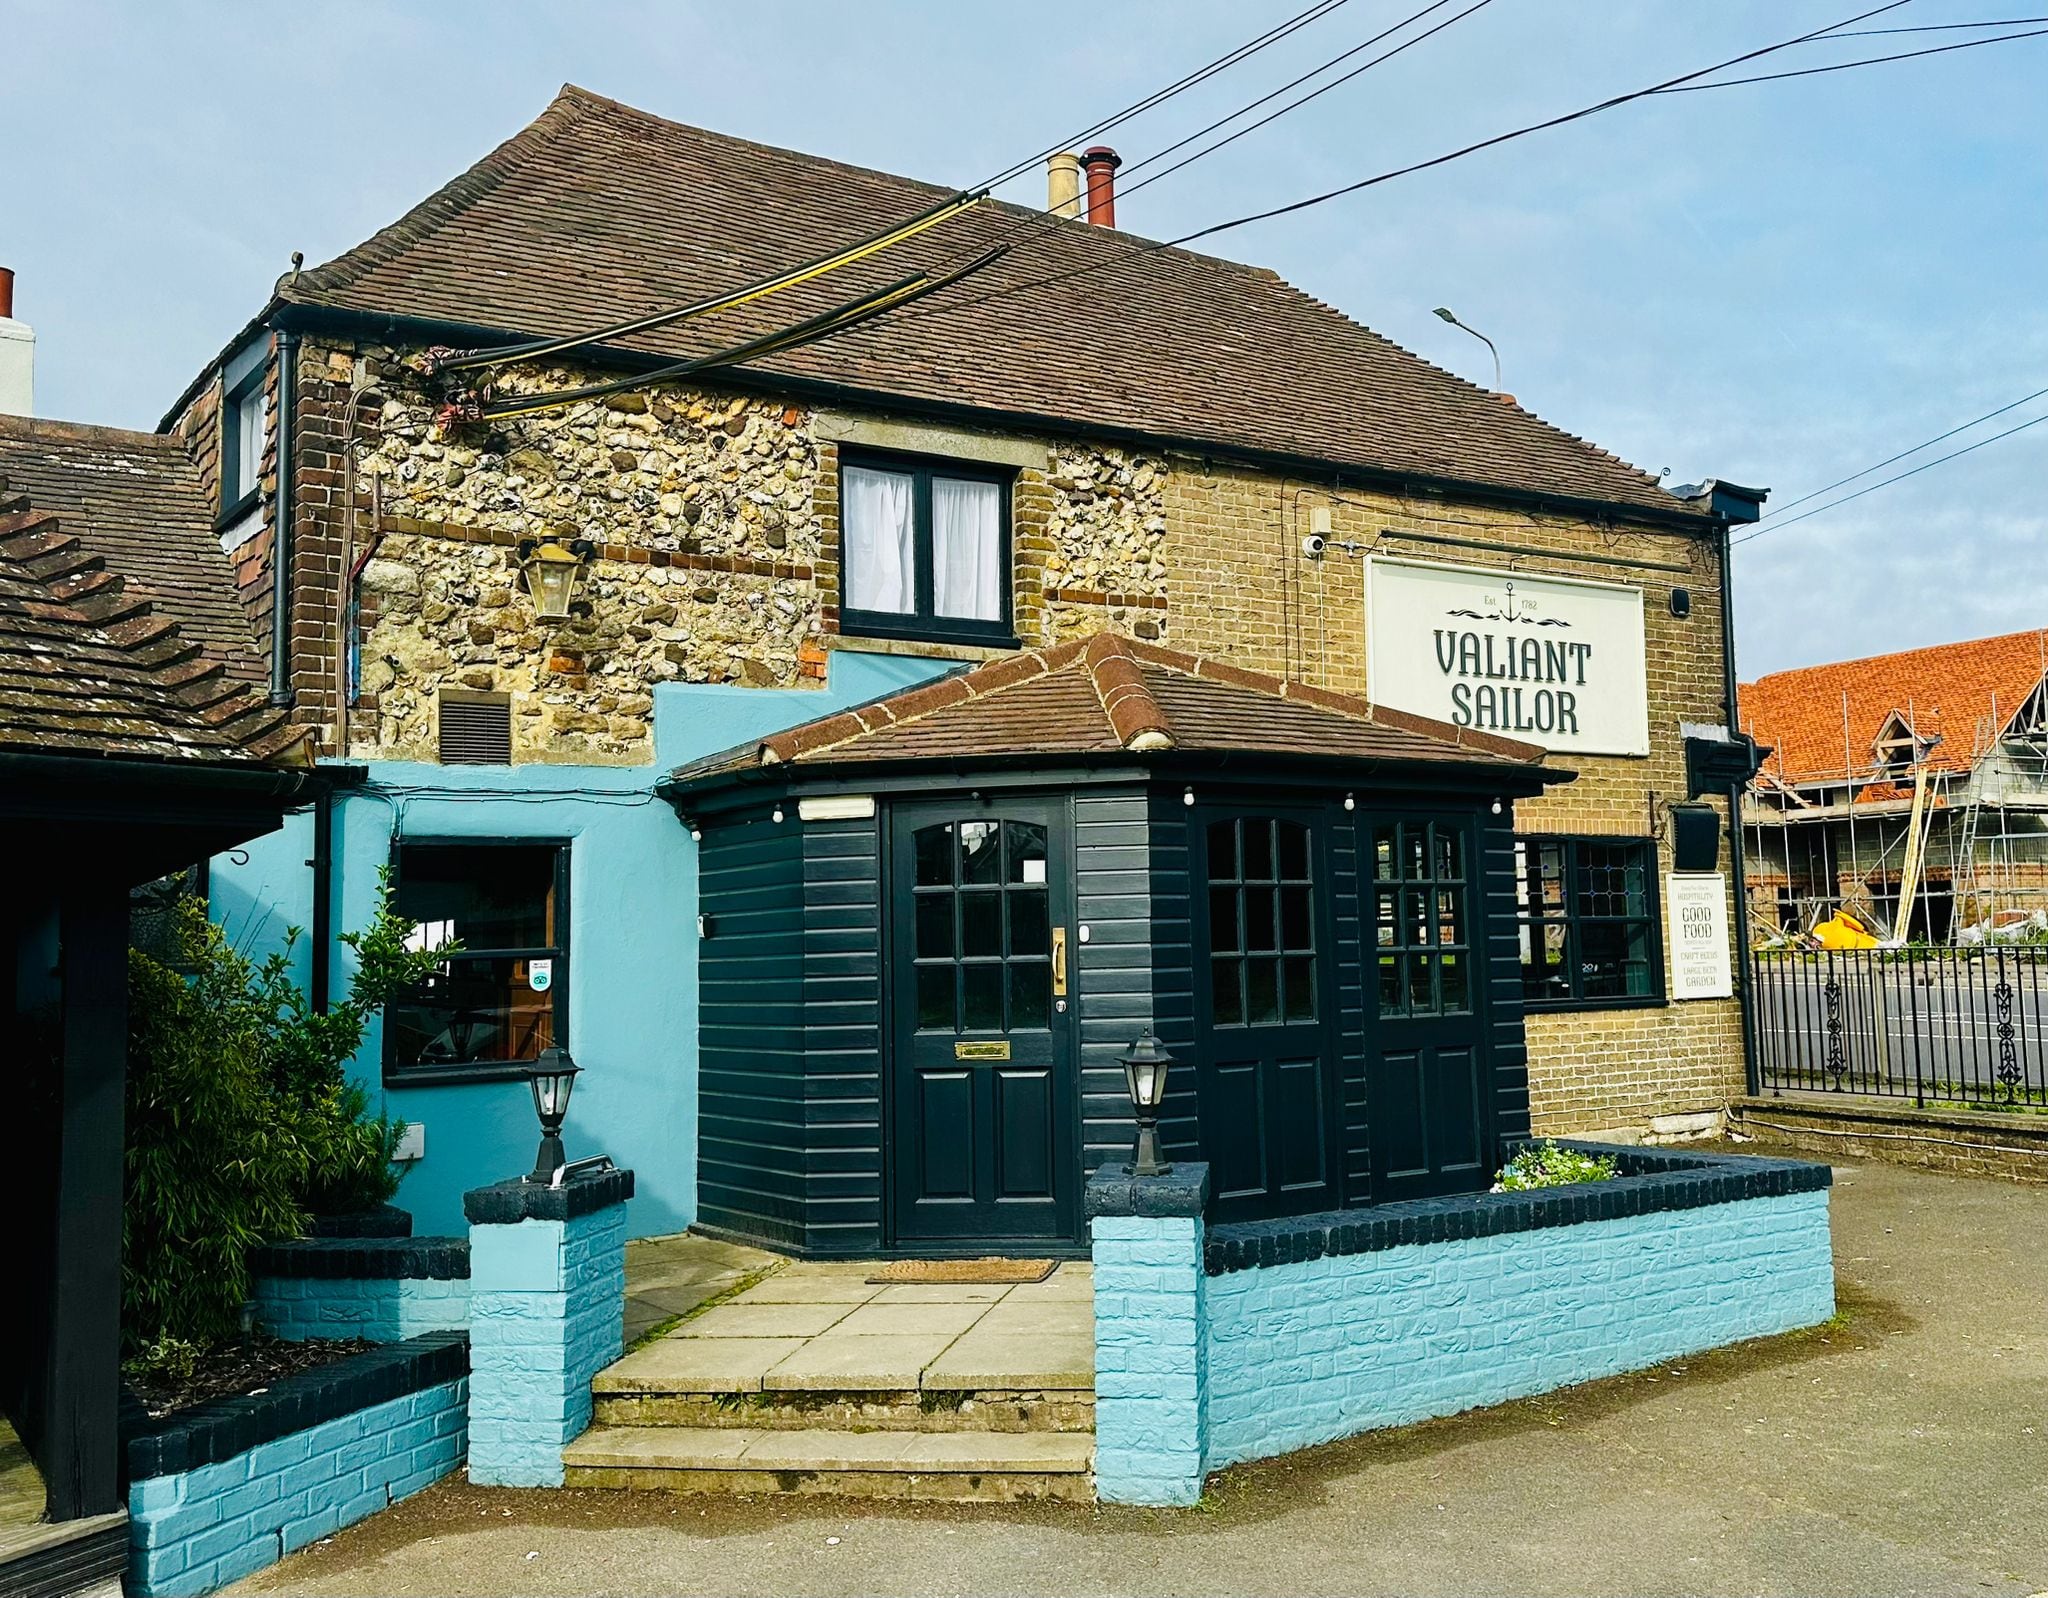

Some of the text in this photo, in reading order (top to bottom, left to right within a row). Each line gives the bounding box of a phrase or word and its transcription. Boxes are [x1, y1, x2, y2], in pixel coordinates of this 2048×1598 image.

[1484, 595, 1497, 606] Est
[1521, 600, 1538, 610] 1782
[1433, 629, 1592, 685] VALIANT
[1451, 682, 1579, 735] SAILOR
[1682, 906, 1712, 922] GOOD
[1683, 923, 1712, 939] FOOD
